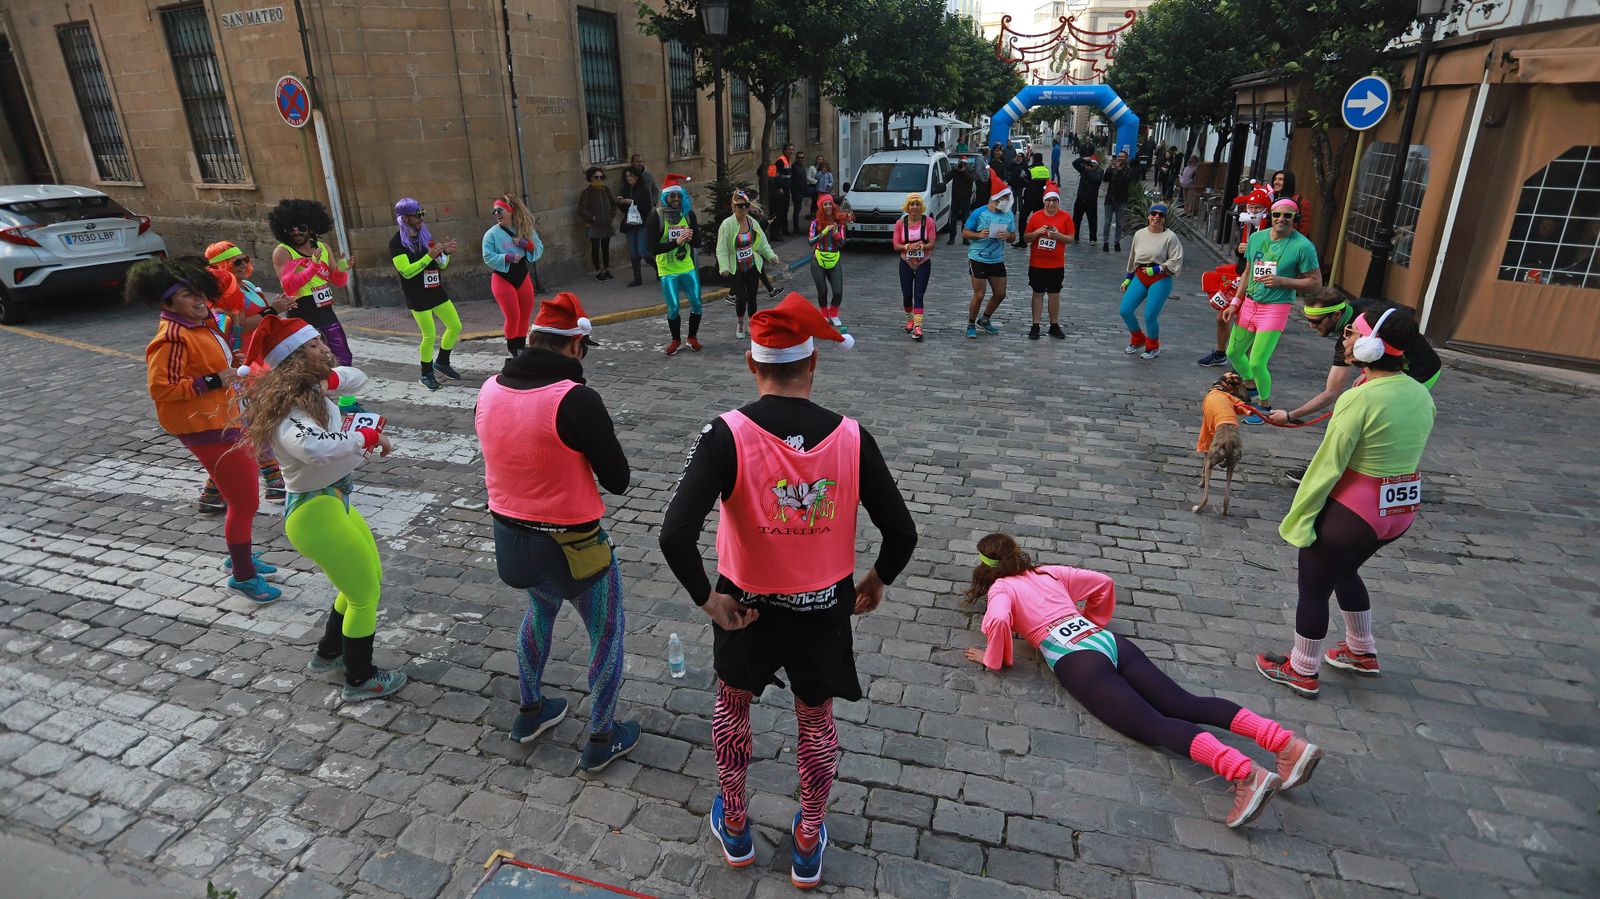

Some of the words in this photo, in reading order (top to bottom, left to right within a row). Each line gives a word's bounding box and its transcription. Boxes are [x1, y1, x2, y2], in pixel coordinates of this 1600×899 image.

[223, 12, 244, 27] SAN
[246, 7, 283, 25] MATEO
[71, 232, 96, 244] 7030
[98, 230, 115, 240] LBP
[1039, 239, 1054, 248] 042
[1254, 267, 1272, 276] 056
[1385, 485, 1418, 503] 055
[757, 525, 832, 536] TARIFA
[1058, 618, 1090, 638] 054
